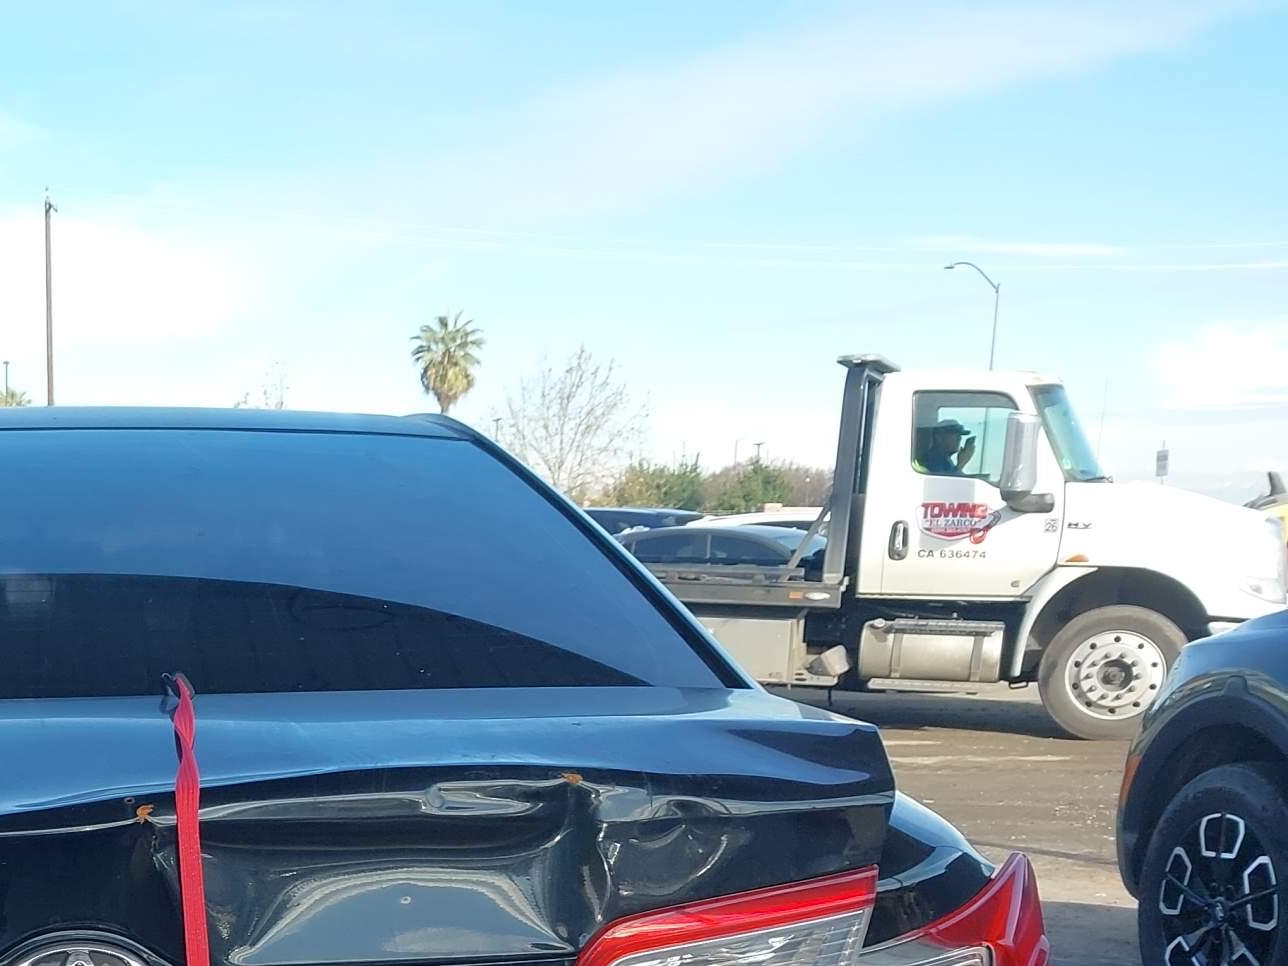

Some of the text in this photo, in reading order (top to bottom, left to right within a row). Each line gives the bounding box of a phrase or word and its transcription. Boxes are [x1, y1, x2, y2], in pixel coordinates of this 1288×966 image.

[921, 503, 987, 519] TOWING
[917, 549, 987, 559] CA 636474
